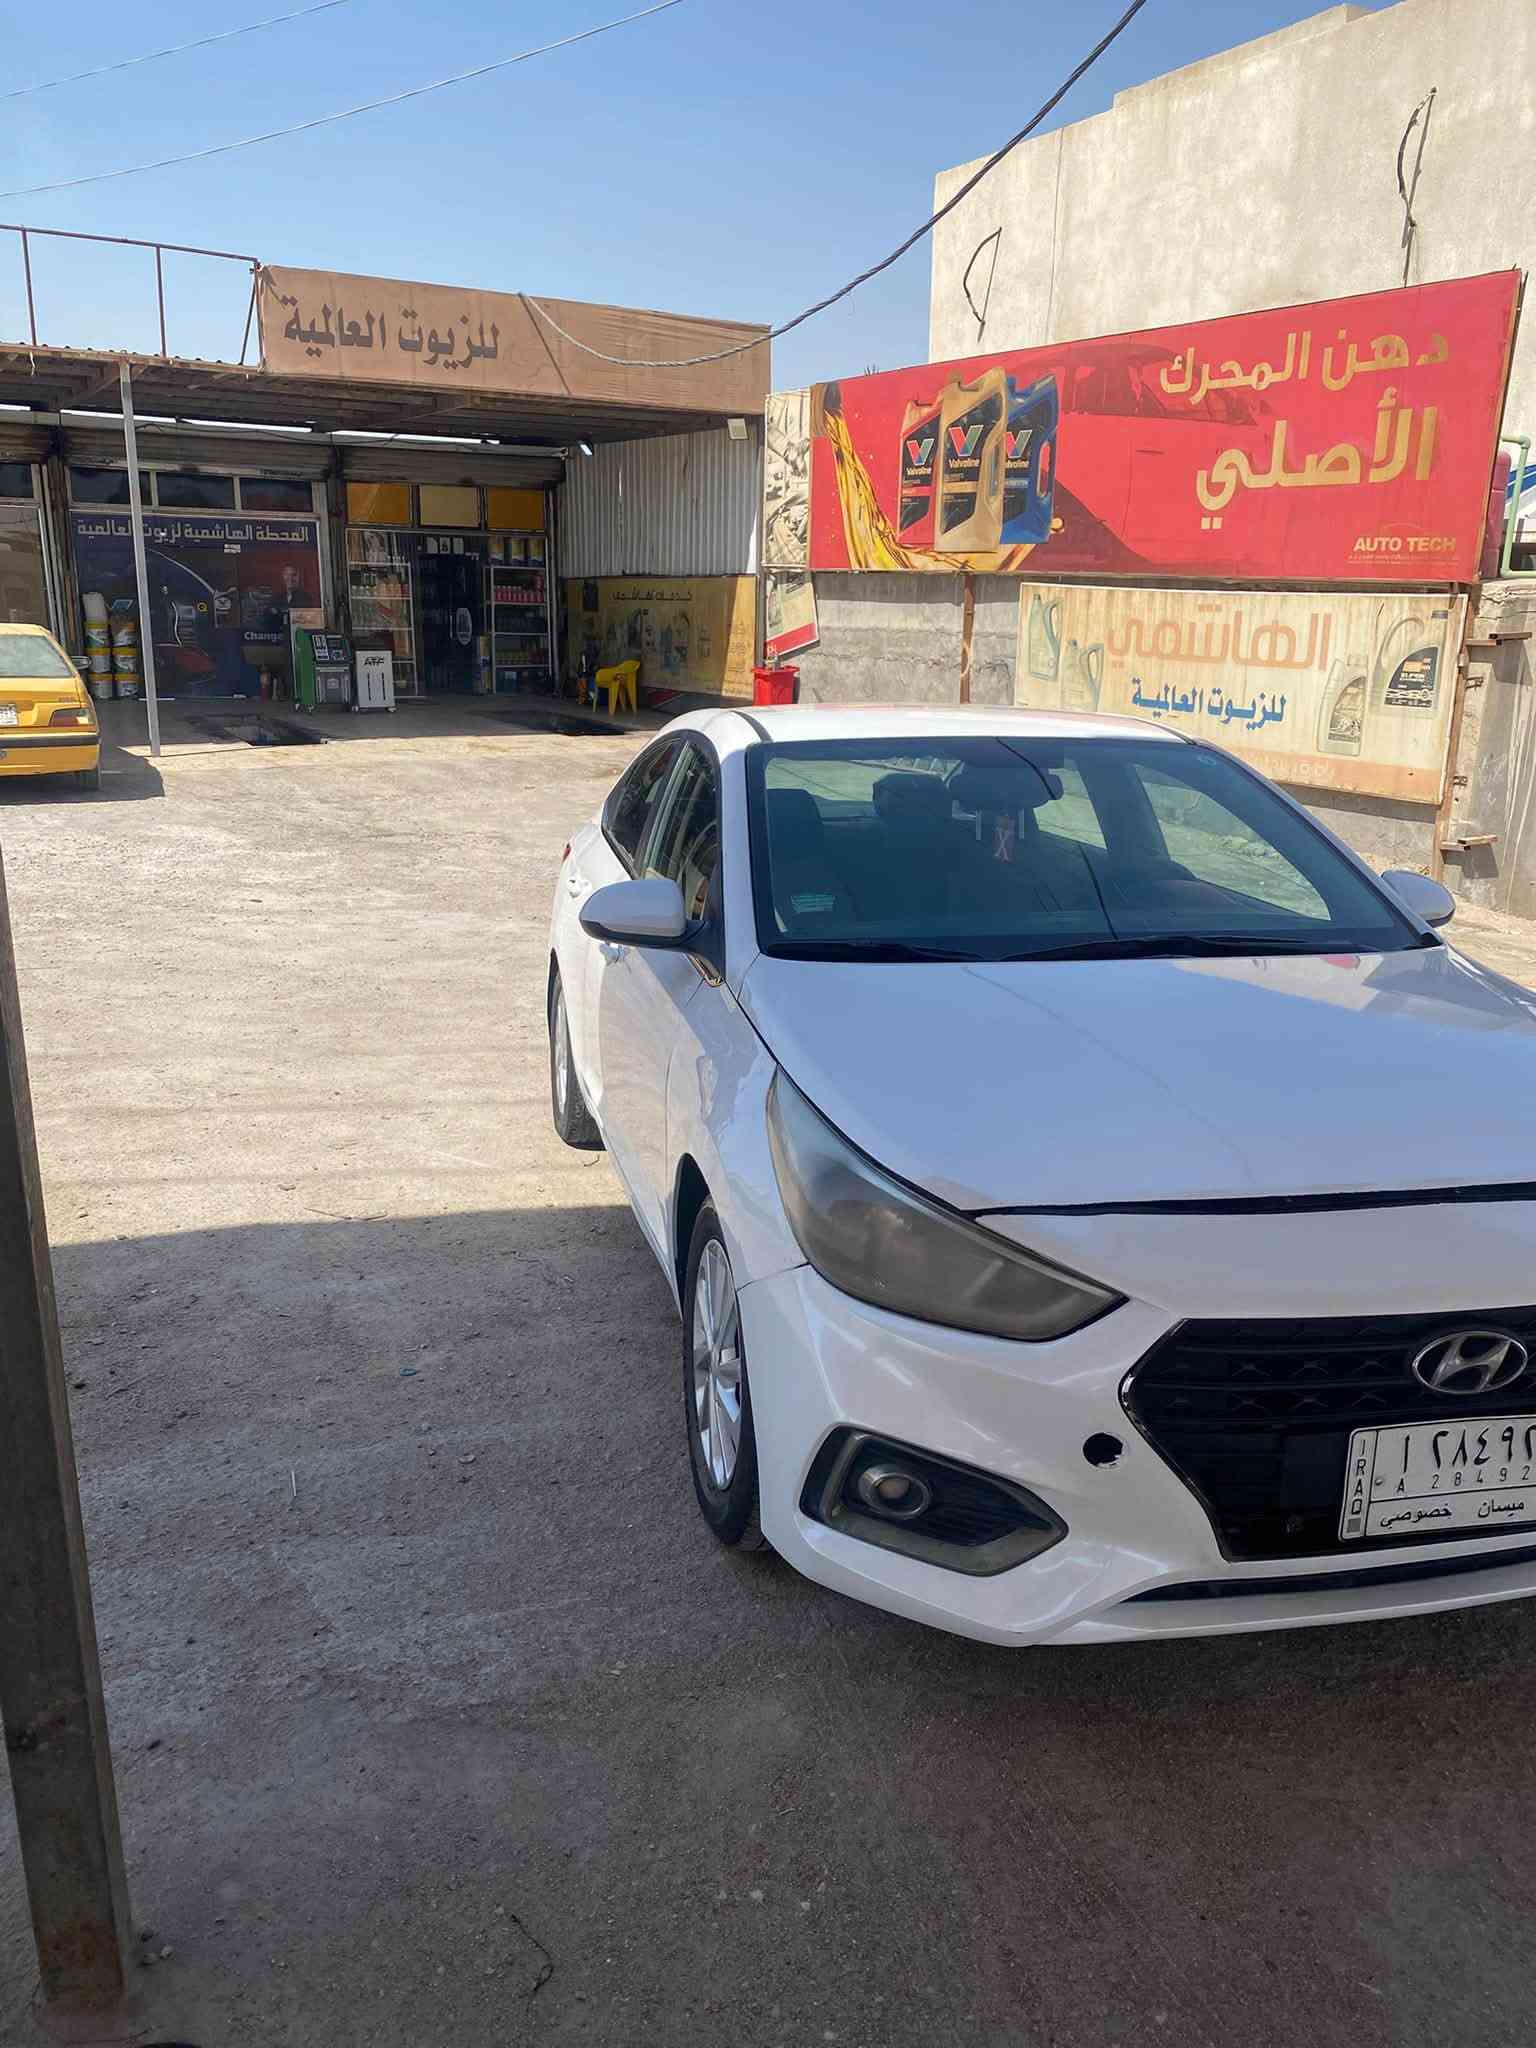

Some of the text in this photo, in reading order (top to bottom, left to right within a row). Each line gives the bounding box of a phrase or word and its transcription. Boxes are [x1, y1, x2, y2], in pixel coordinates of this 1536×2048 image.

[281, 295, 500, 370] للزيوت العالمية
[1159, 328, 1450, 405] دهن المحرك
[1196, 386, 1438, 530] الأصلي
[184, 522, 253, 541] الهاشمية
[256, 525, 309, 542] المحطة
[1353, 537, 1457, 552] AUTO TECH
[1107, 603, 1332, 672] الهاشمي
[1131, 677, 1287, 730] للزيوت العالمية
[1350, 1439, 1367, 1515] IRAQ
[1379, 1499, 1526, 1530] ميسان خصوصي
